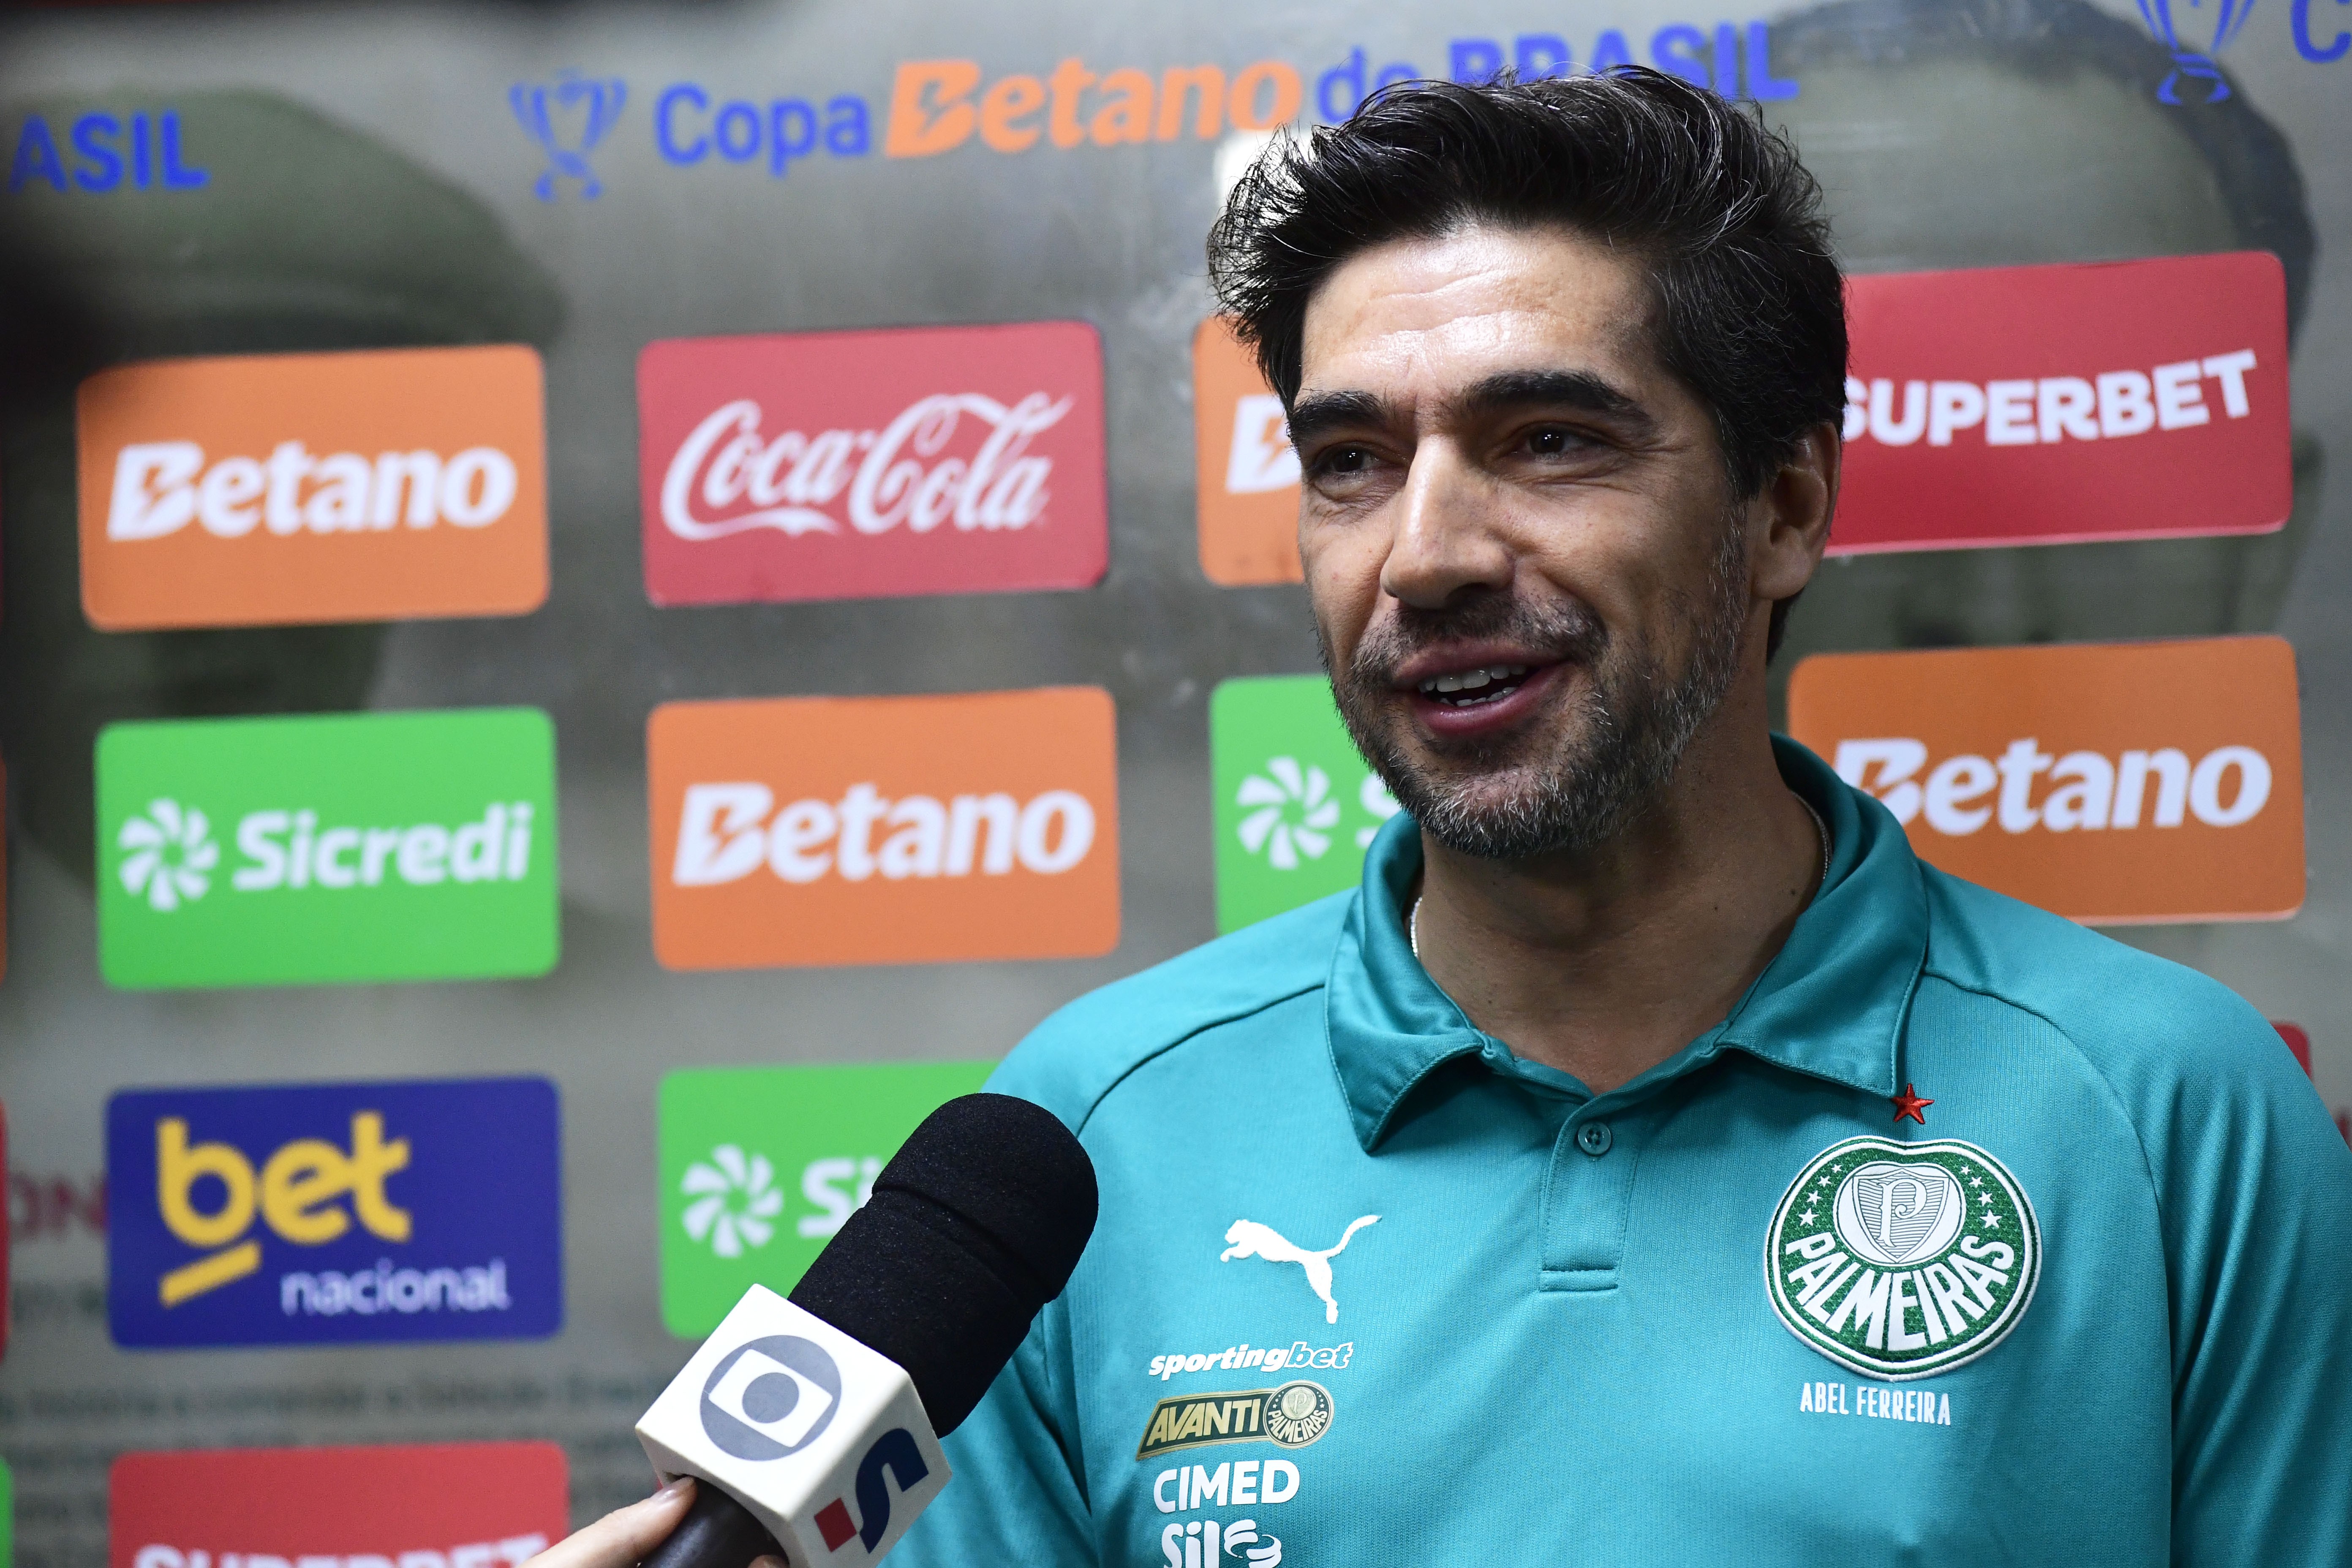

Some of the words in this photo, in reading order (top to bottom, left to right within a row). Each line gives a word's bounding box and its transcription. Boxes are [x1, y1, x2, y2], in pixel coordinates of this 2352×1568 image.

[656, 82, 871, 177] Copa
[885, 57, 1303, 159] Betano
[106, 440, 517, 541] Betano
[661, 391, 1076, 541] Coca-Cola
[672, 781, 1096, 887] Betano
[1835, 738, 2272, 836] Betano
[232, 801, 534, 891] Sicredi
[157, 1111, 412, 1247] bet
[280, 1258, 510, 1316] nacional
[1785, 1232, 2015, 1352] PALMEIRAS
[1148, 1341, 1353, 1381] sportingbet
[1800, 1382, 1849, 1416] ABEL
[1857, 1386, 1951, 1426] FERREIRA
[1146, 1399, 1261, 1446] AVANTI
[1268, 1410, 1328, 1443] PALMEIRAS
[1153, 1459, 1300, 1513] CIMED
